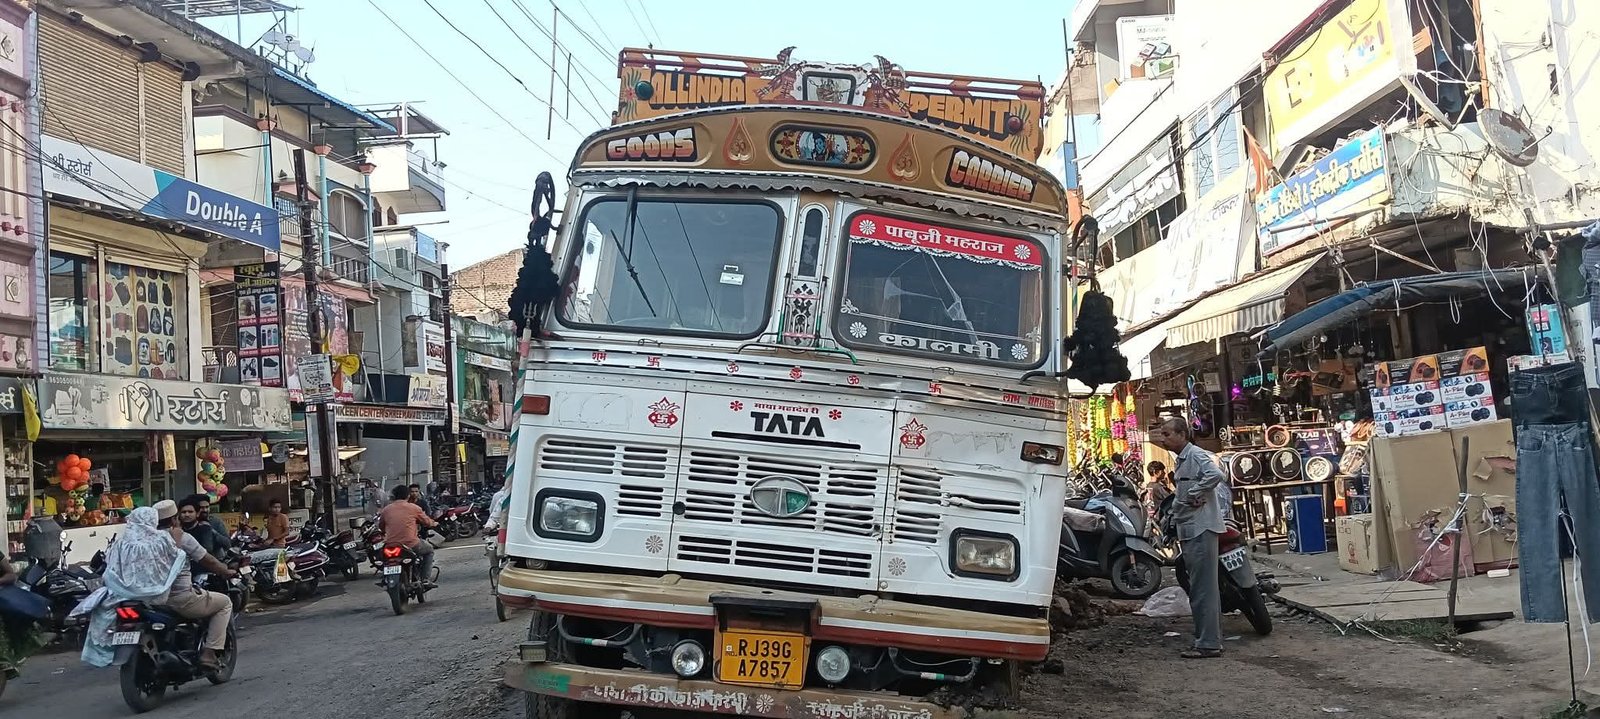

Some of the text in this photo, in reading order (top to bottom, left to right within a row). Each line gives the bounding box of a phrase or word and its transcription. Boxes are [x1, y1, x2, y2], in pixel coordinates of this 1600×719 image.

[910, 92, 1011, 135] PERMIT
[607, 127, 694, 159] GOODS
[66, 158, 93, 177] स्टोर्स
[949, 150, 1034, 201] CARRIER
[185, 190, 263, 236] Double A
[884, 227, 942, 245] पाबूजी
[167, 387, 229, 423] स्टोर्स
[750, 411, 825, 438] TATA
[738, 638, 791, 659] RJ39G
[738, 659, 791, 679] A7857
